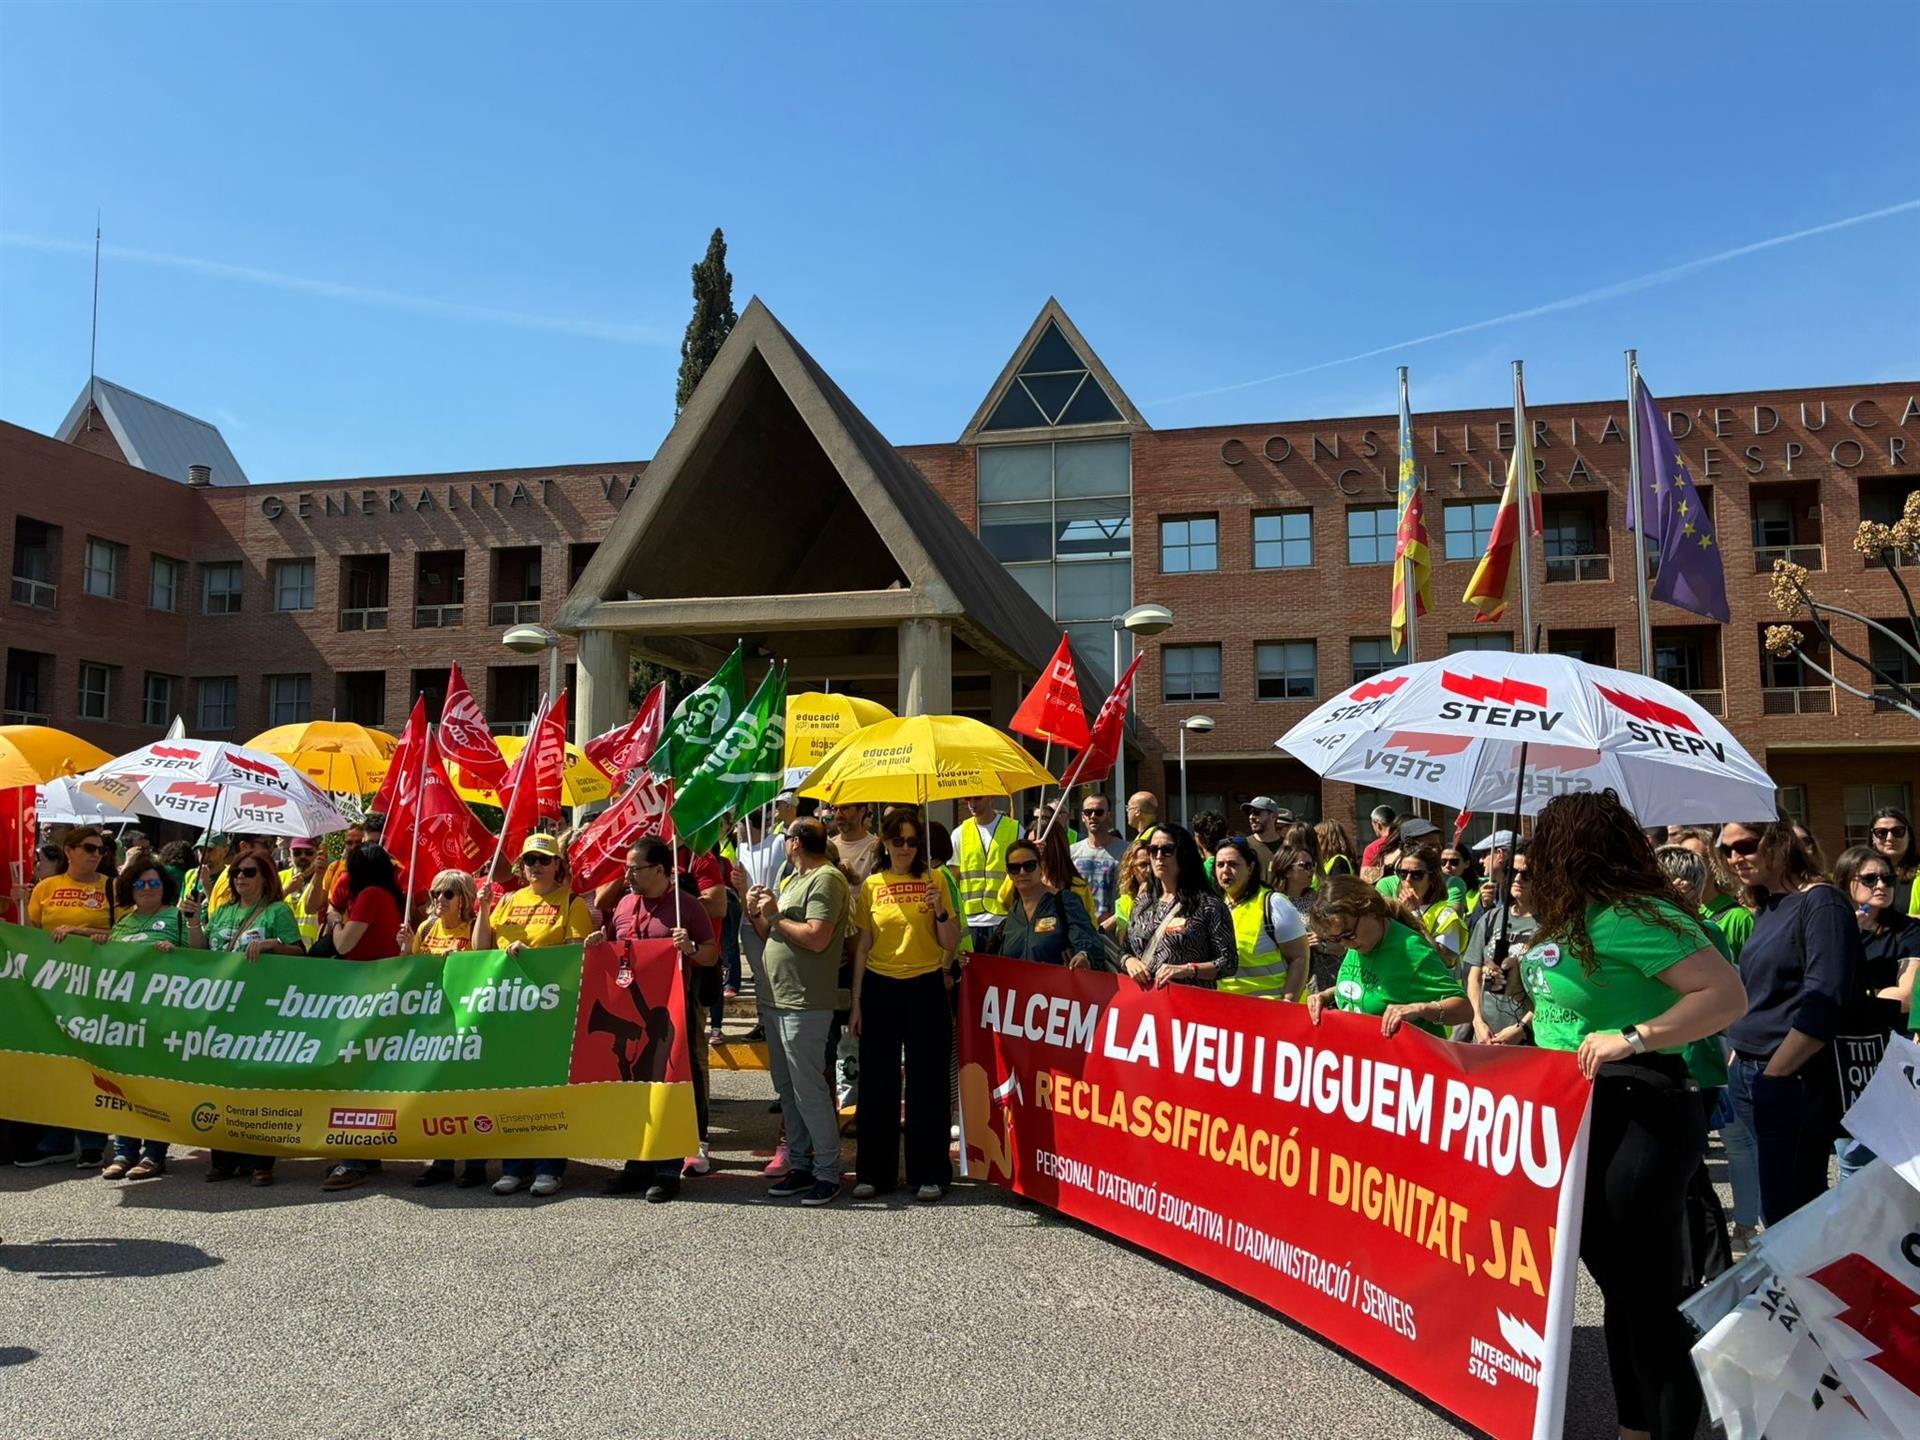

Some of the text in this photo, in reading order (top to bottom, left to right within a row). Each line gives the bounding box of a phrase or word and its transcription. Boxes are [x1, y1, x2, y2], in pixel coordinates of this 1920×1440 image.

[1220, 415, 1625, 465] CONSLLERIA
[261, 478, 554, 519] GENERALITAT
[796, 712, 840, 721] educació
[1324, 695, 1395, 723] STEPV
[1438, 702, 1564, 731] STEPV
[862, 743, 913, 758] educació
[1626, 721, 1725, 763] STEPV
[142, 758, 202, 771] STEPV
[876, 759, 888, 767] en
[232, 768, 290, 791] STEPV
[95, 968, 136, 1003] HA
[141, 973, 246, 1012] PROU!
[163, 1025, 322, 1064] +plantilla
[980, 985, 1563, 1189] ALCEM LA VEU I DIGUEM PROU
[196, 1110, 220, 1125] CSIF
[226, 1104, 303, 1117] Central Sindical
[332, 1112, 375, 1126] CCOO
[500, 1111, 566, 1124] Ensenyament
[226, 1117, 303, 1132] Independiente y
[422, 1116, 469, 1137] UGT
[558, 1123, 569, 1132] PV
[228, 1130, 301, 1144] de Funcionarios
[326, 1131, 398, 1146] educació
[1035, 1071, 1300, 1188] RECLASSIFICACIÓ
[1308, 1147, 1319, 1197] I
[1328, 1152, 1476, 1277] DIGNITAT,
[1036, 1149, 1417, 1341] PERSONAL D'ATENCIÓ EDUCATIVA I D'ADMINISTRACIÓ I SERVEIS
[1468, 1356, 1497, 1387] STAS
